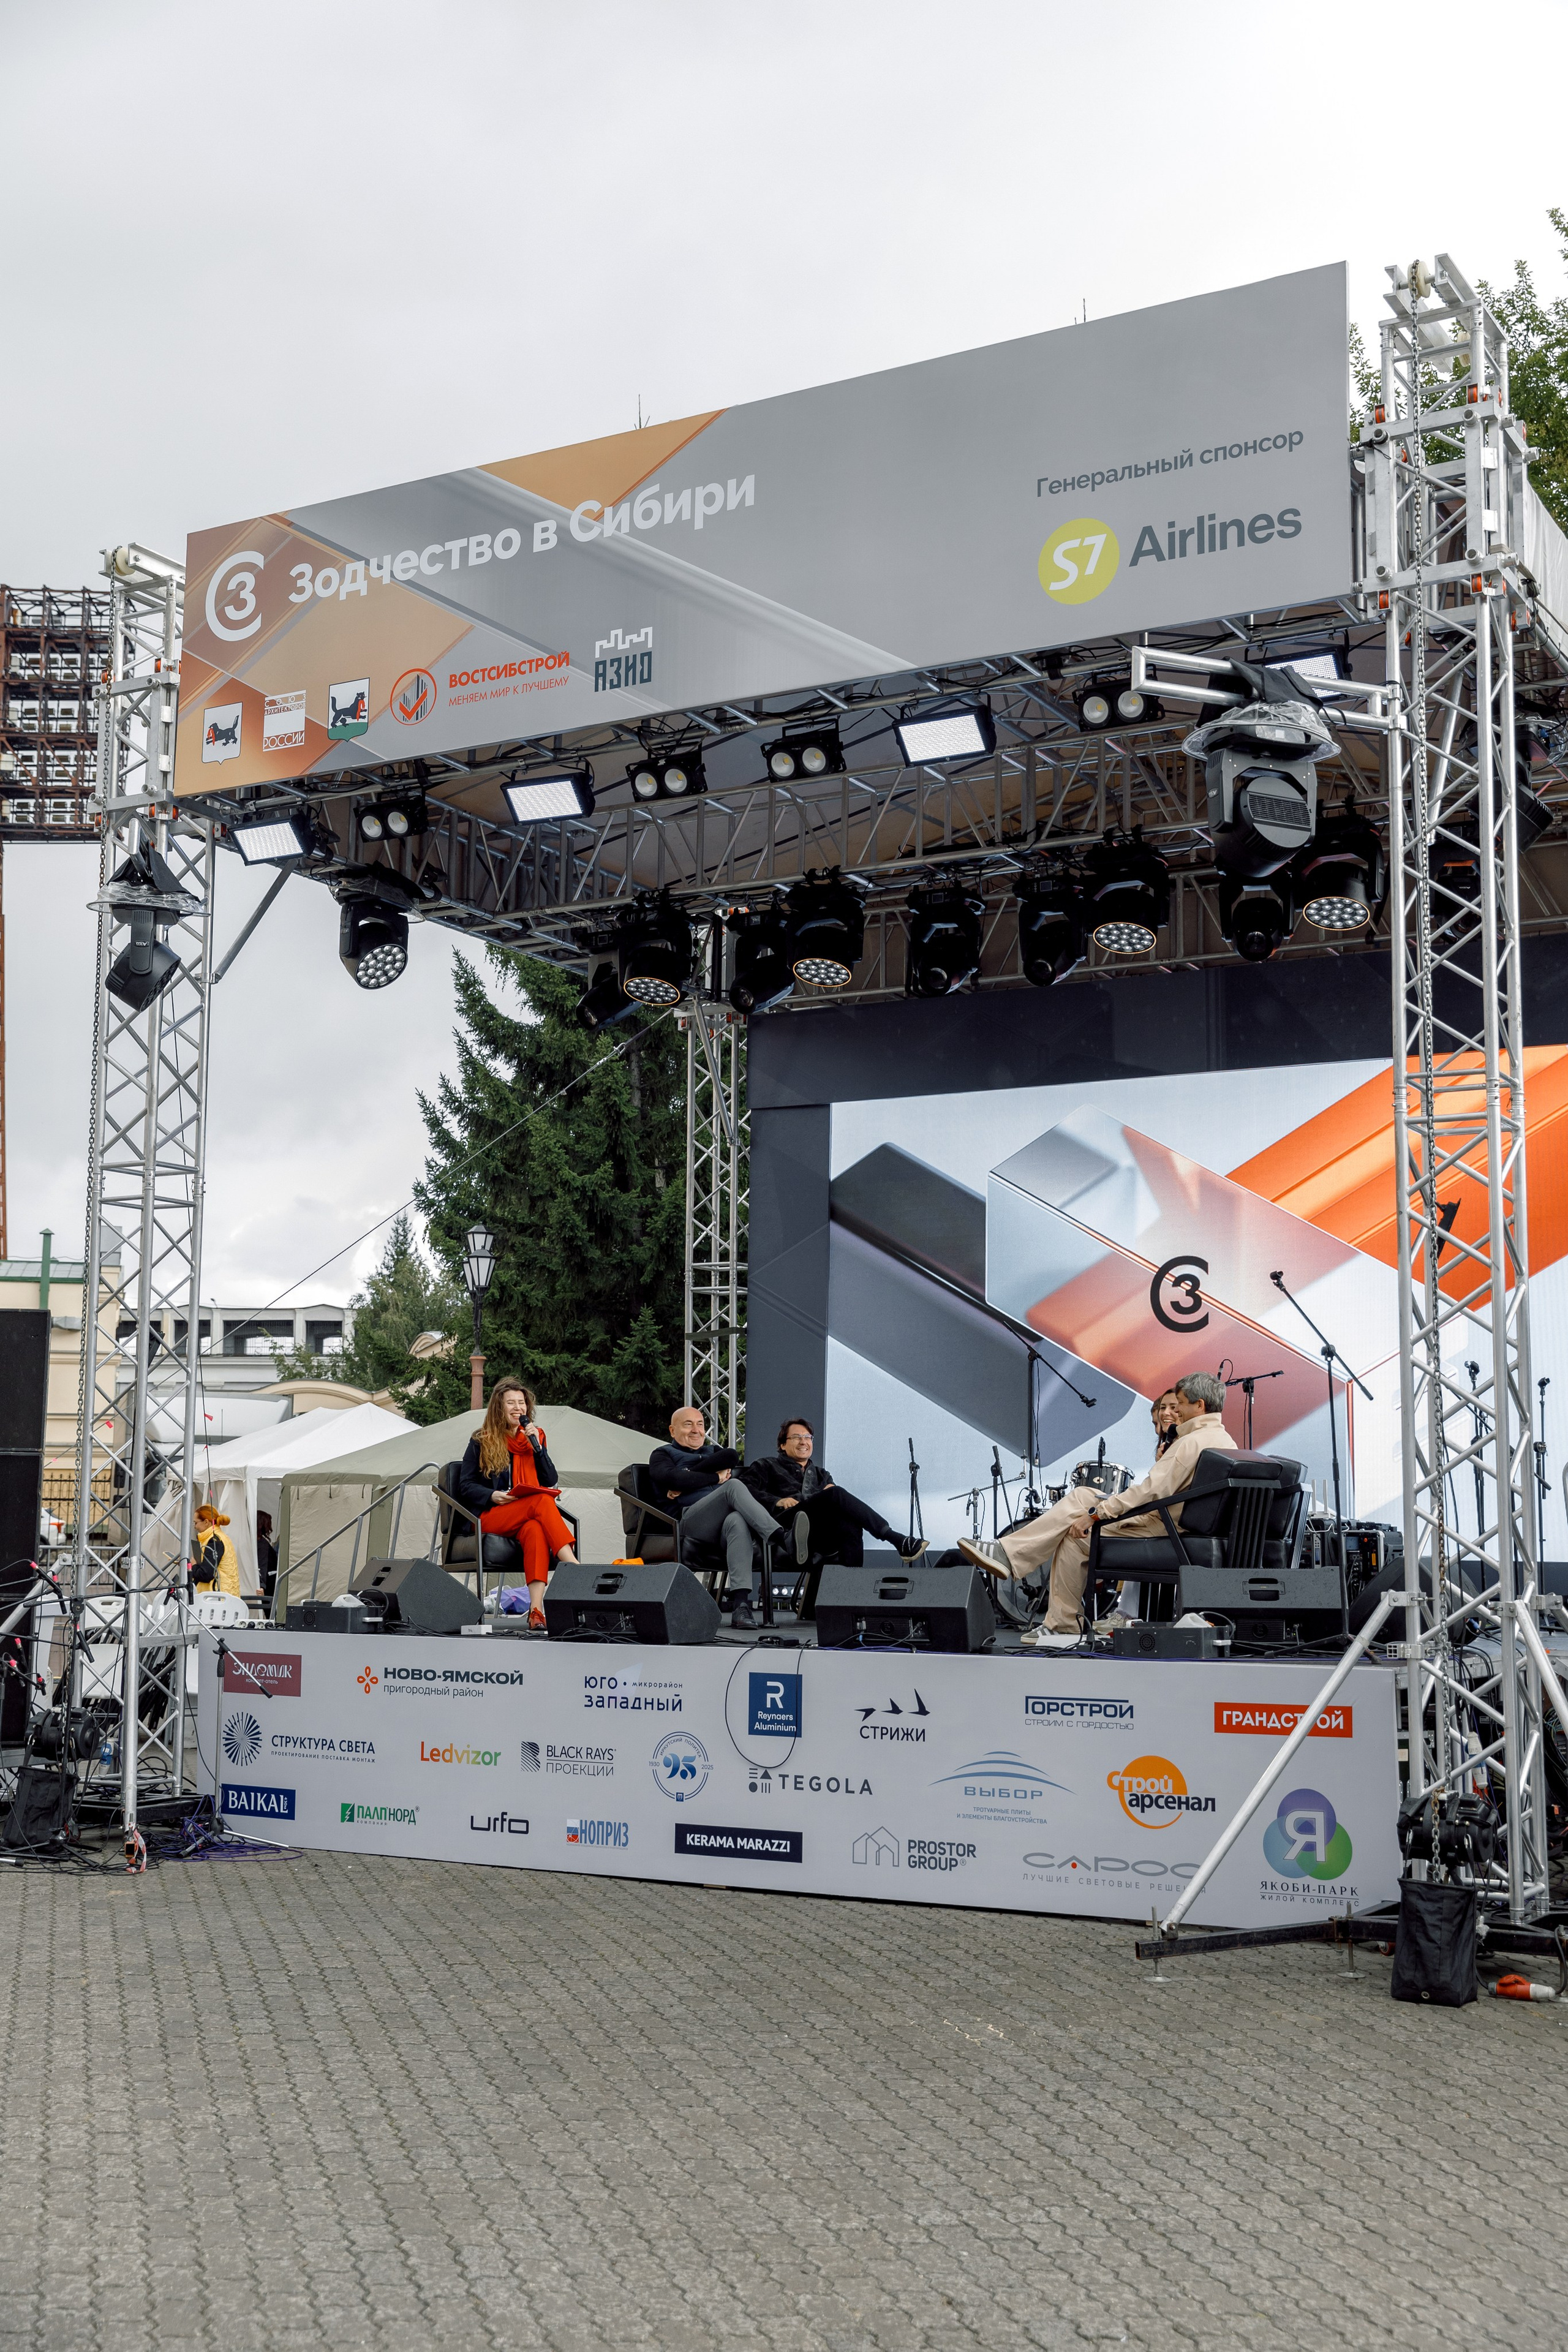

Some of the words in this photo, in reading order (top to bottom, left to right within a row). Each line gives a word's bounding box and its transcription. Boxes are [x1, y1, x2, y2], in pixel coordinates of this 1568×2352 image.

[1036, 448, 1193, 497] Генеральный
[1199, 430, 1304, 464] спонсор
[288, 527, 521, 603] Зодчество
[533, 519, 558, 552] в
[569, 475, 755, 543] Сибири
[1128, 507, 1302, 567] Airlines
[1049, 533, 1107, 591] S7
[449, 650, 570, 688] ВОСТСИБСТРОЙ
[448, 688, 488, 707] МЕНЯЕМ
[489, 684, 510, 699] МИР
[513, 682, 519, 695] К
[521, 676, 570, 693] ЛУЧШЕМУ
[264, 701, 306, 716] АРХИТЕКТОРОВ
[263, 731, 305, 750] РОССИИ
[383, 1667, 523, 1686] НОВО-ЯМСКОЙ
[383, 1684, 450, 1697] пригородный
[453, 1687, 483, 1699] район
[758, 1711, 793, 1721] Reynaers
[1076, 1721, 1134, 1730] ГОРДОСТЬЮ
[1223, 1710, 1344, 1730] ГРАНДСТОЙ
[754, 1722, 796, 1732] Aluminium
[859, 1725, 926, 1743] СТРИЖИ
[271, 1735, 336, 1751] СТРУКТУРА
[339, 1740, 375, 1754] СВЕТА
[421, 1741, 502, 1766] Ledvizor
[546, 1745, 582, 1759] BLACK
[586, 1747, 614, 1761] RAYS
[660, 1737, 683, 1756] ИРКУТСКИЙ
[684, 1739, 702, 1758] ПОЛИТЕХ
[271, 1751, 319, 1759] ПРОЕКТИРОВАНИЕ
[546, 1762, 614, 1777] ПРОЕКЦИИ
[778, 1773, 873, 1795] TEGOLA
[964, 1786, 1043, 1800] ВЫБОР
[228, 1790, 288, 1814] BAIKAL
[1128, 1793, 1216, 1814] арсенал
[470, 1811, 529, 1834] urfo
[993, 1816, 1047, 1825] БЛАГОУСТРОЙСТВА
[579, 1819, 629, 1847] НОПРИЗ
[1283, 1809, 1326, 1863] Я
[686, 1833, 735, 1849] KERAMA
[737, 1837, 790, 1853] MARAZZI
[908, 1839, 977, 1858] PROSTOR
[908, 1855, 959, 1871] GROUP
[1022, 1873, 1069, 1883] ЛУЧШИЕ
[1079, 1877, 1140, 1890] СВЕТОВЫЕ
[1150, 1883, 1206, 1894] РЕШЕЯ
[1259, 1880, 1359, 1897] ЯКОБИ-ПАРК
